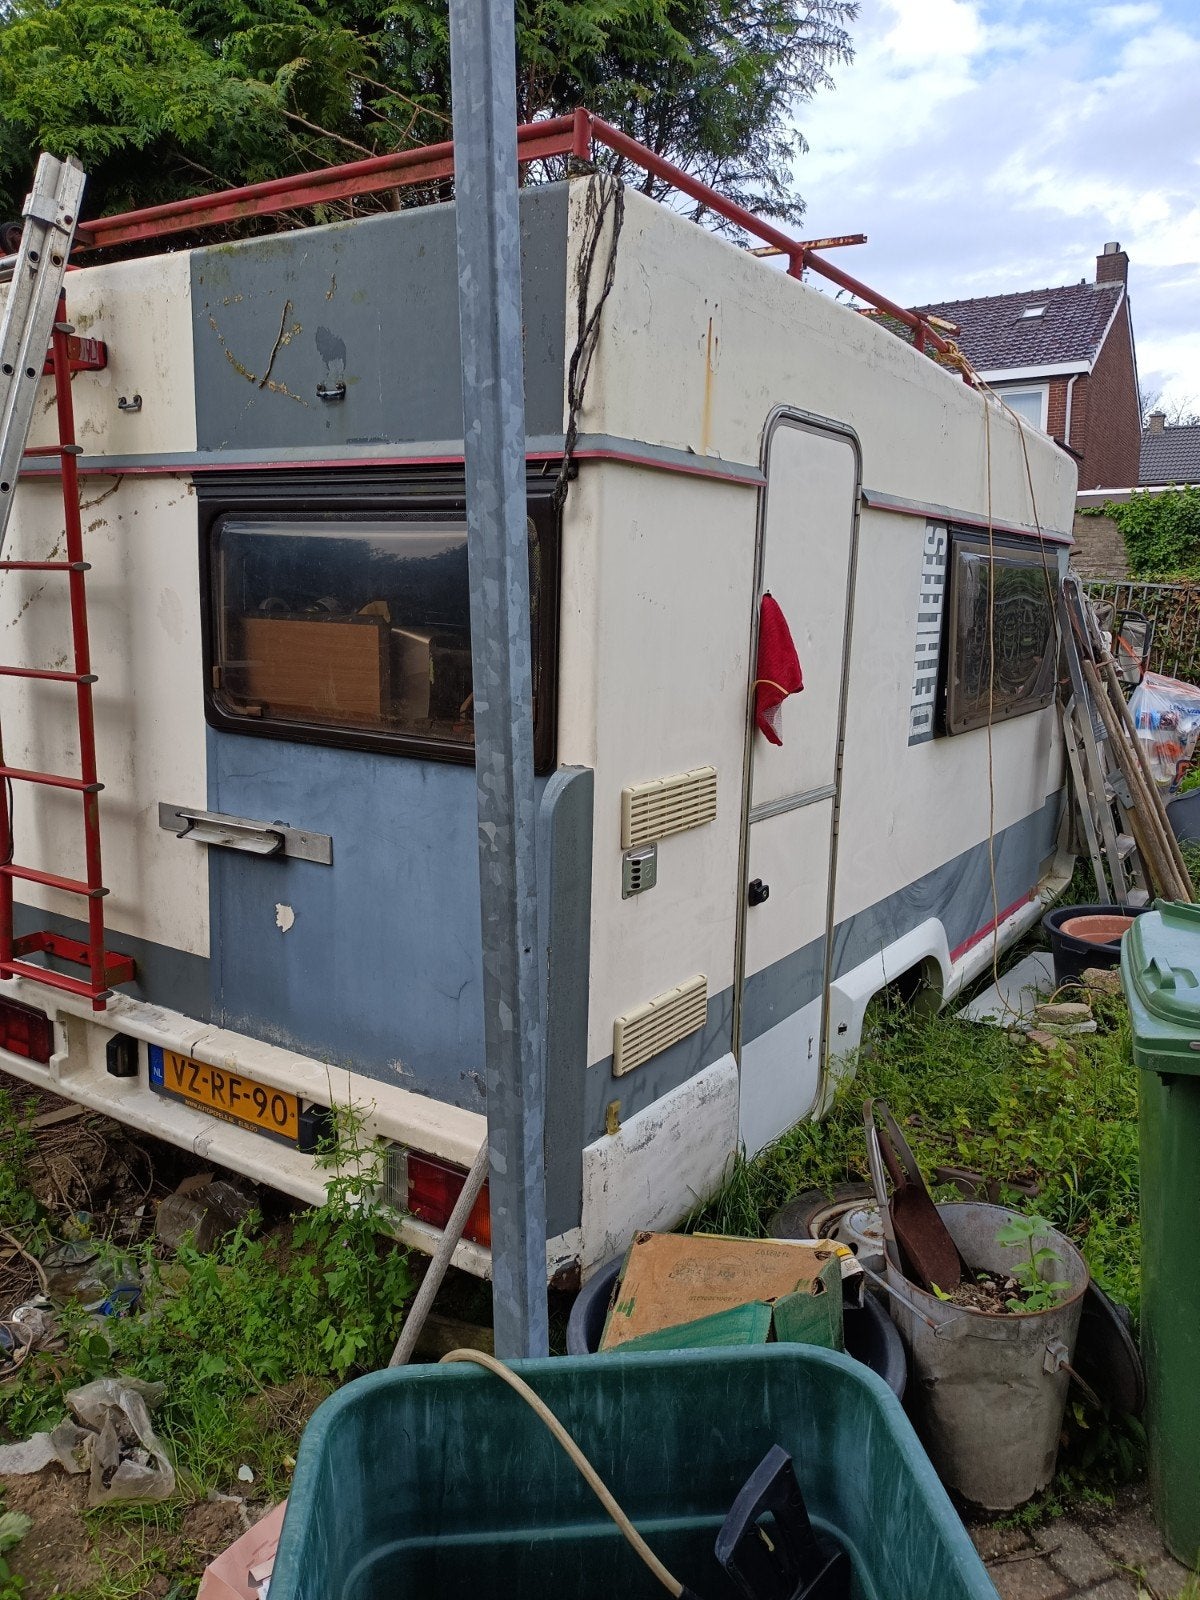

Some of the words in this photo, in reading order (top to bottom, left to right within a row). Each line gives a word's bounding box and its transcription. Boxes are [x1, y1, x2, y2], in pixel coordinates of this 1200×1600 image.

[908, 525, 948, 736] DETHLEFFS
[152, 1066, 163, 1078] NL
[171, 1055, 288, 1127] VZ-RF-90
